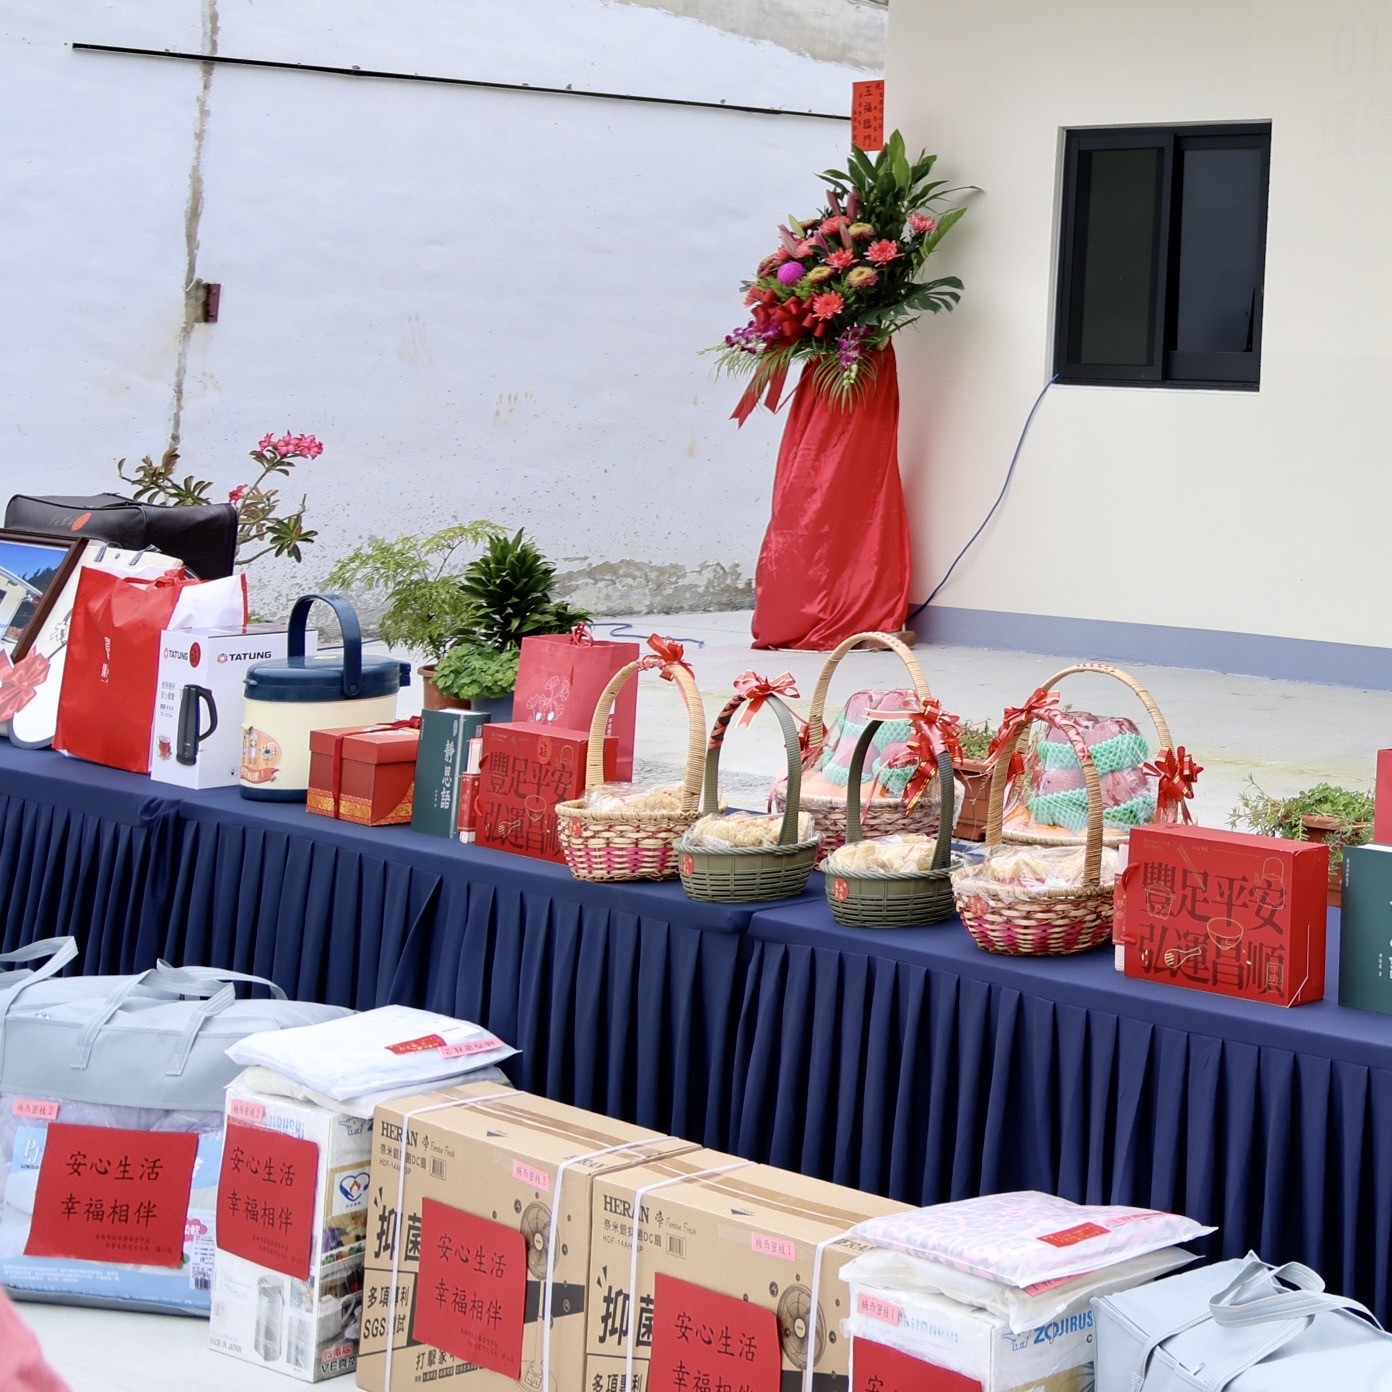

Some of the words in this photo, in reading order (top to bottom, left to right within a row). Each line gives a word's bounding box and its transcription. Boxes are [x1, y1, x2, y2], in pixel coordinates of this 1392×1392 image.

[169, 650, 188, 660] TATUNG
[229, 651, 272, 661] TATUNG
[441, 740, 455, 809] 靜思語
[487, 751, 574, 806] 豐足平安
[1139, 861, 1287, 936] 豐足平安
[1138, 924, 1286, 998] 弘運昌順
[381, 1121, 418, 1148] HERAN
[66, 1151, 163, 1181] 安心生活
[231, 1146, 295, 1187] 安心生活
[61, 1193, 157, 1227] 幸福相伴
[228, 1189, 293, 1235] 幸福相伴
[437, 1233, 506, 1279] 安心生活
[435, 1278, 502, 1330] 幸福相伴
[674, 1311, 757, 1362] 安心生活
[1034, 1310, 1094, 1345] ZOJIRUS
[228, 1340, 242, 1354] JAPAN
[415, 1349, 455, 1371] 打擊家
[673, 1360, 753, 1392] 幸福
